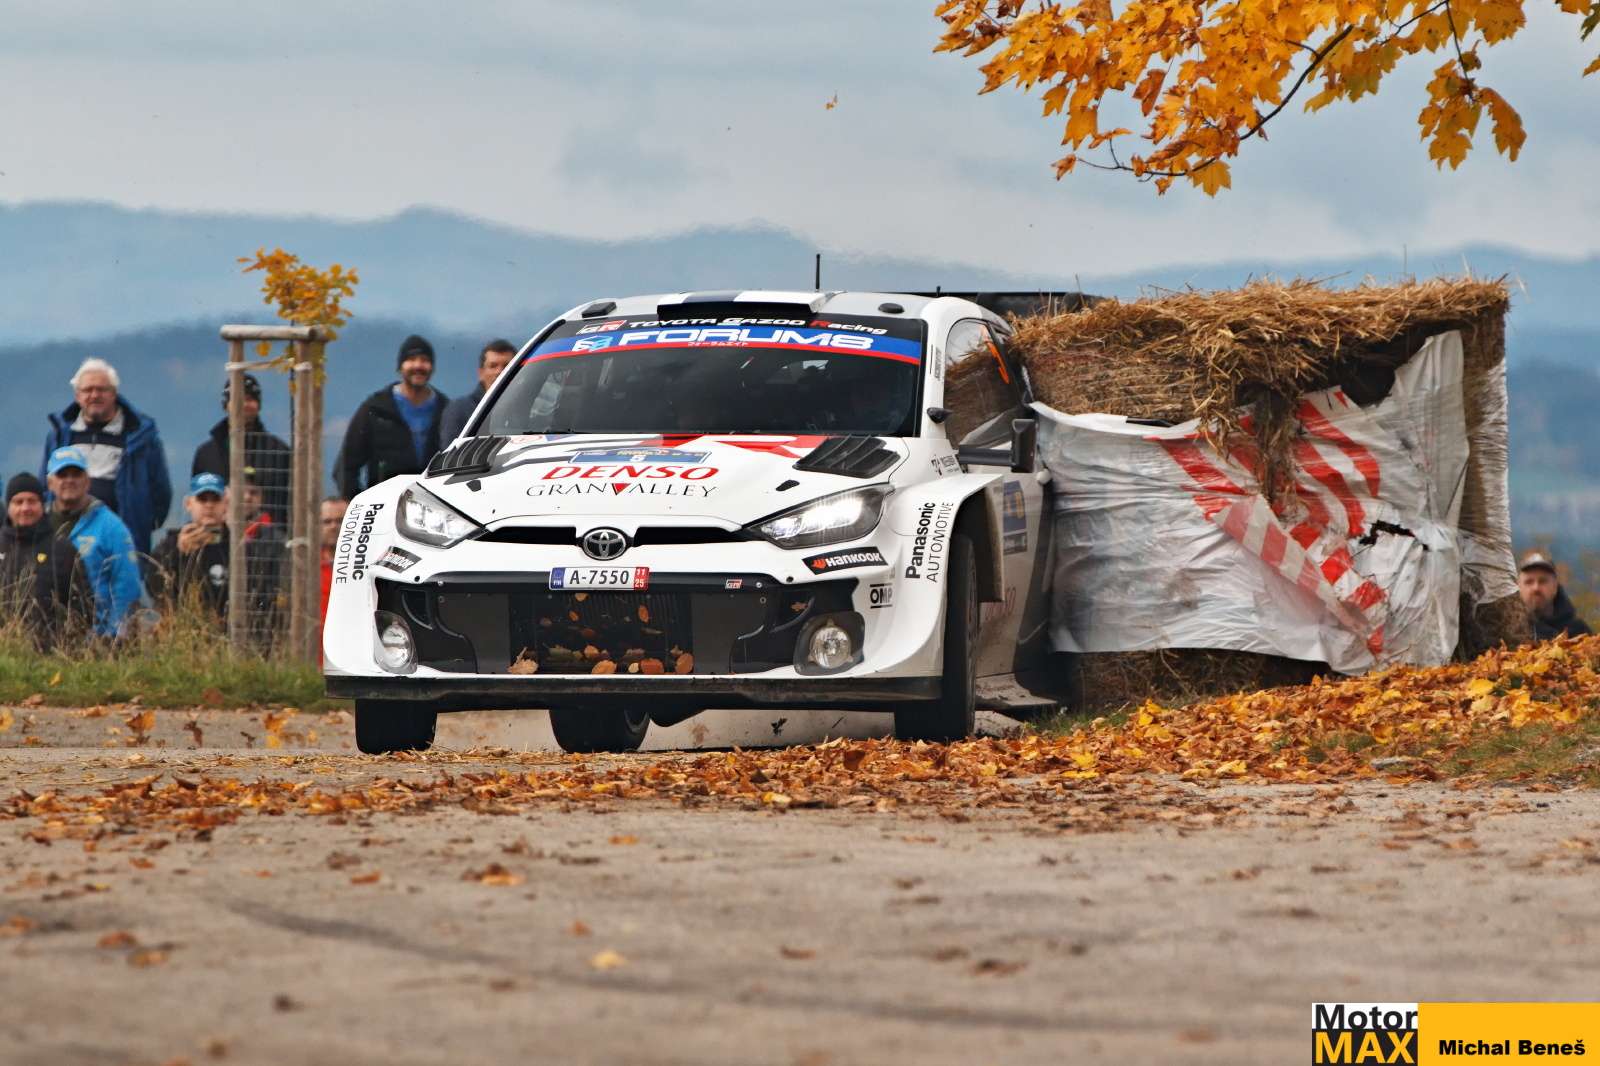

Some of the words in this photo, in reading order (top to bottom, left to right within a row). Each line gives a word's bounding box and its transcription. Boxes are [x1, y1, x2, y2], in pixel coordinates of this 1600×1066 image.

[629, 319, 717, 328] TOYOTA
[717, 317, 806, 326] GAZOO
[809, 320, 888, 335] Racing
[618, 328, 874, 350] FORUM8
[541, 465, 719, 480] DENSO
[336, 504, 364, 584] AUTOMOTIVE
[352, 503, 384, 580] Panasonic
[905, 502, 936, 579] Panasonic
[926, 502, 954, 583] AUTOMOTIVE
[569, 570, 630, 585] A-7550
[634, 580, 644, 588] 25
[870, 587, 893, 604] OMP
